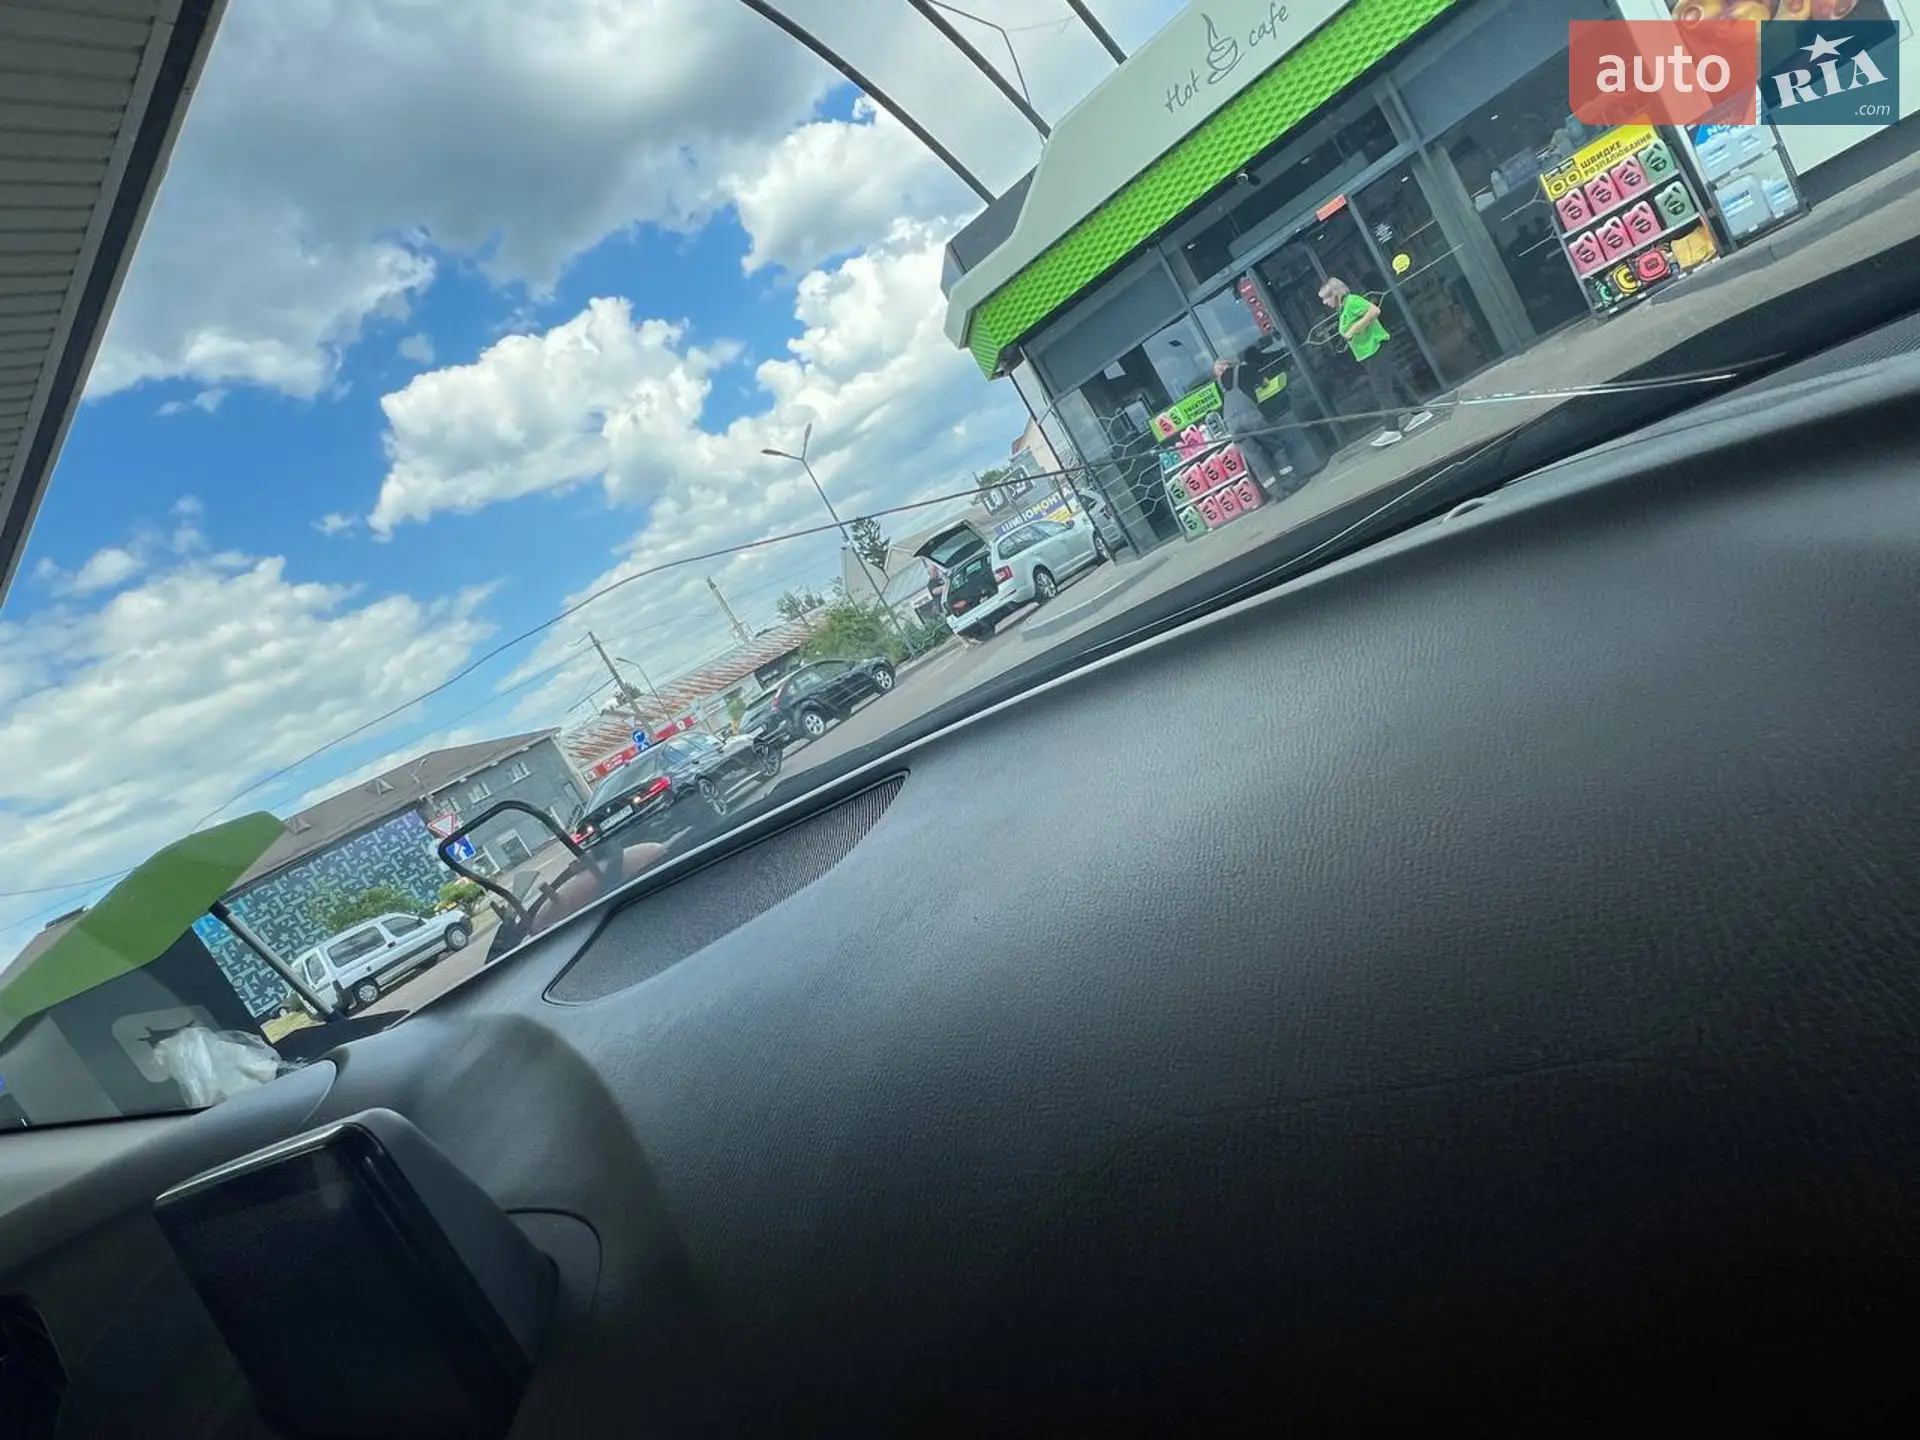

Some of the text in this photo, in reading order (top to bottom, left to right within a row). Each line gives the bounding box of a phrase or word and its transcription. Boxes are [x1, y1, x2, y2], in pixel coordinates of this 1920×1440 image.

[1165, 2, 1288, 113] Hot cafe
[1580, 141, 1621, 169] ШВИДКЕ
